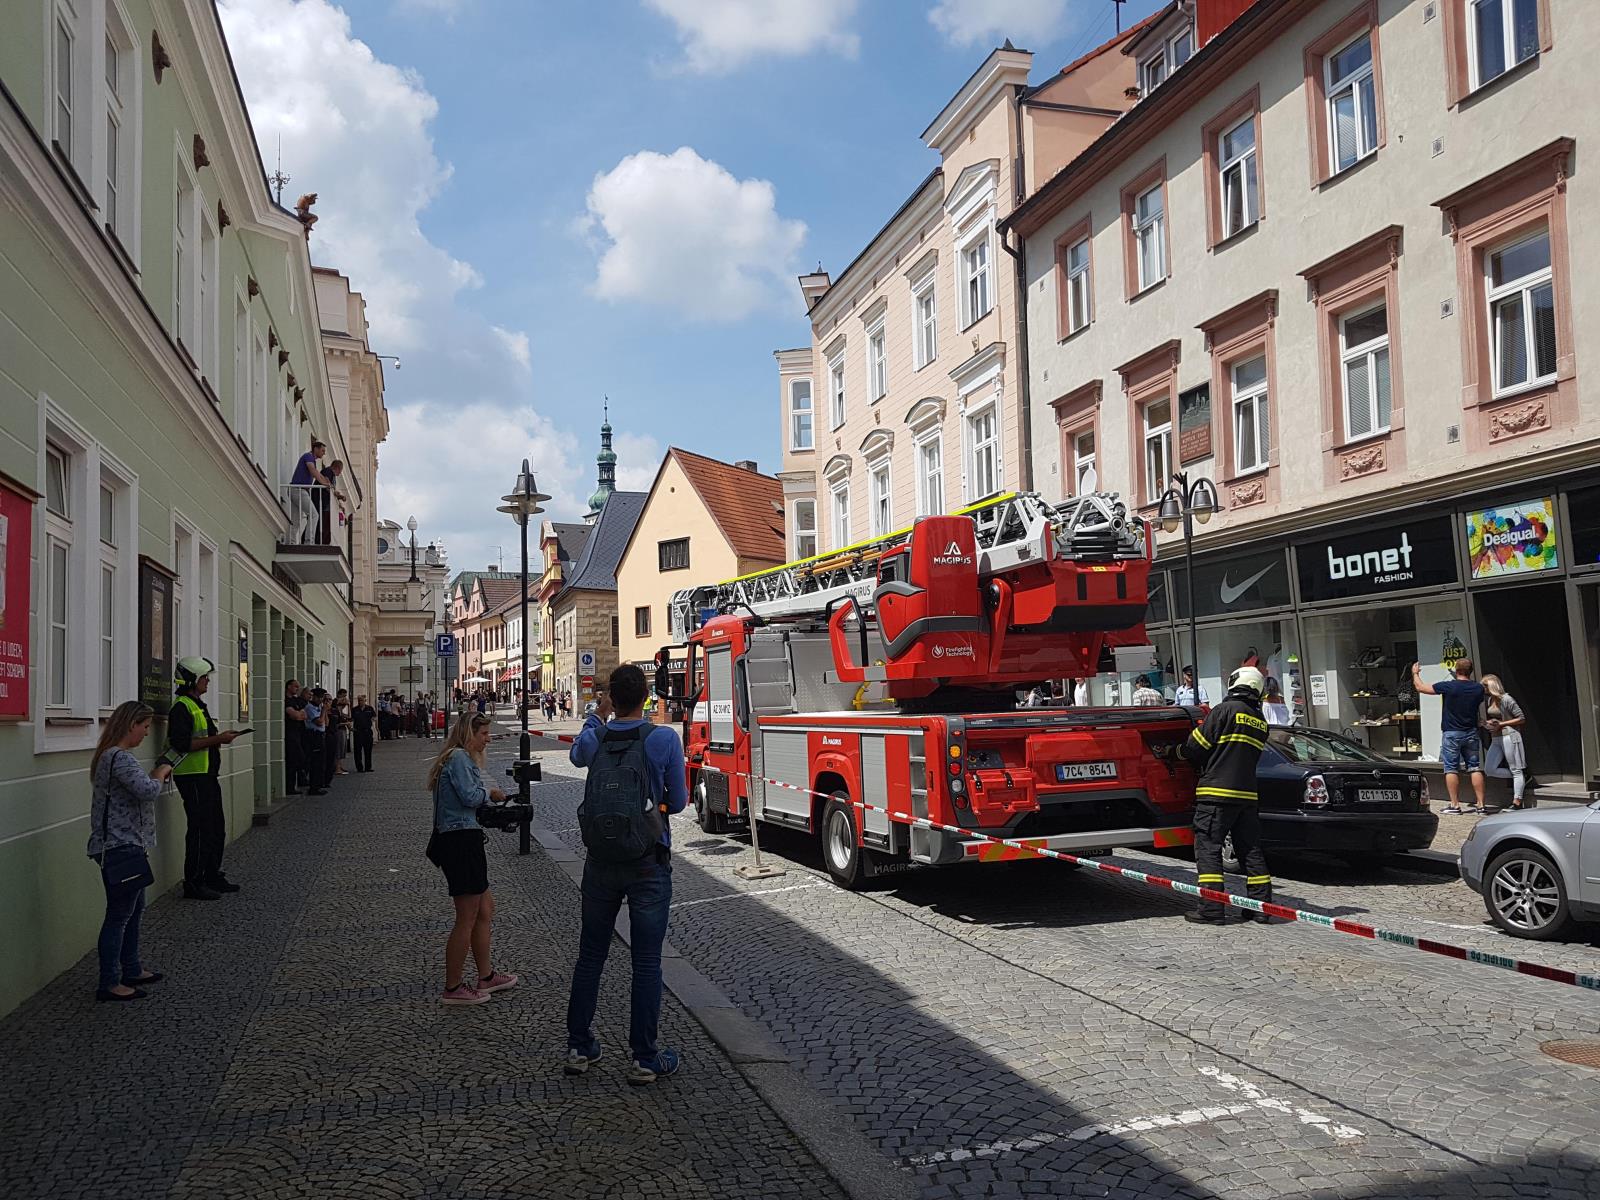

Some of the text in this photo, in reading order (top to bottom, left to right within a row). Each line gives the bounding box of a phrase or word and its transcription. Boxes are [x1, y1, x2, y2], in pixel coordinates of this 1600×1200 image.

[933, 556, 972, 565] MAGIRUS
[1327, 532, 1413, 580] bonet
[1374, 571, 1414, 584] FASHION
[440, 636, 451, 651] P
[1443, 647, 1465, 658] JUST
[1064, 763, 1113, 777] 7C4 8541
[1360, 790, 1399, 800] 2C1 1538
